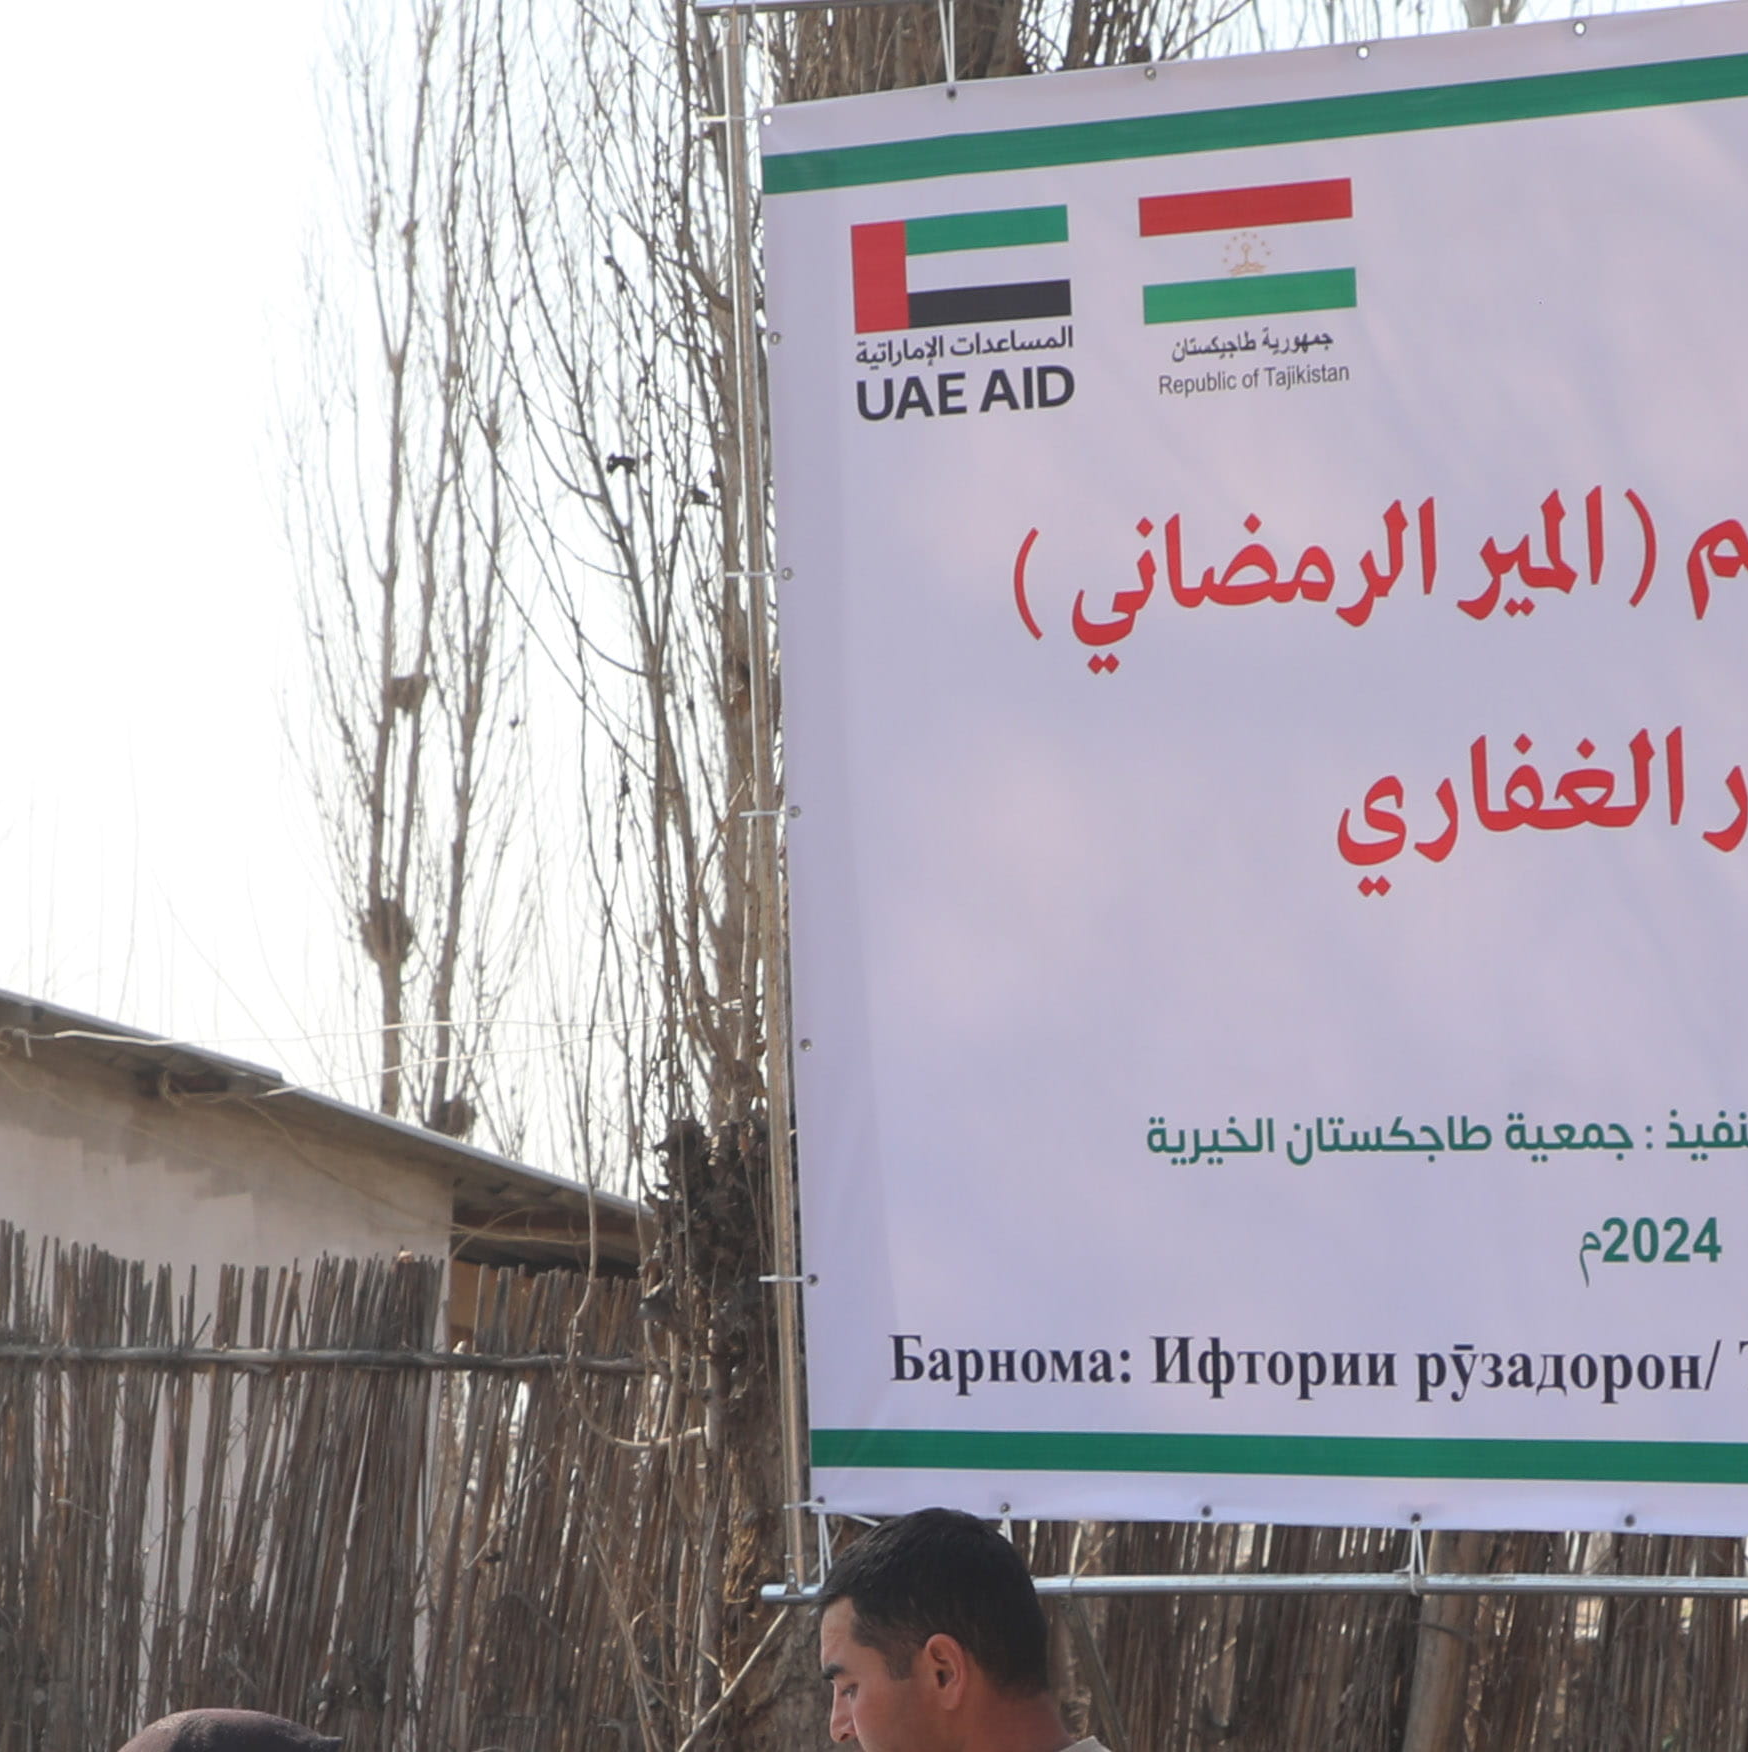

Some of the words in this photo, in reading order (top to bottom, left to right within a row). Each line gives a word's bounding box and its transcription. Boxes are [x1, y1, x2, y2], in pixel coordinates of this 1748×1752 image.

[856, 335, 944, 370] الإماراتية
[950, 325, 1073, 356] المساعدات
[1173, 331, 1256, 362] طاجيكستان
[1263, 328, 1333, 354] جمهورية
[857, 372, 967, 421] UAE
[980, 366, 1074, 412] AID
[1159, 371, 1236, 397] Republic
[1242, 368, 1259, 388] of
[1264, 364, 1349, 390] Tajikistan
[1072, 497, 1436, 674] الرمضاني
[1338, 726, 1684, 896] الغفاري
[1147, 1117, 1274, 1165] الخيرية
[1287, 1116, 1492, 1165] طاجكستان
[1505, 1113, 1633, 1162] جمعية
[891, 1335, 1130, 1396] Барнома:
[1153, 1337, 1395, 1400] Ифтории
[1417, 1340, 1720, 1403] рӯзадорон/
